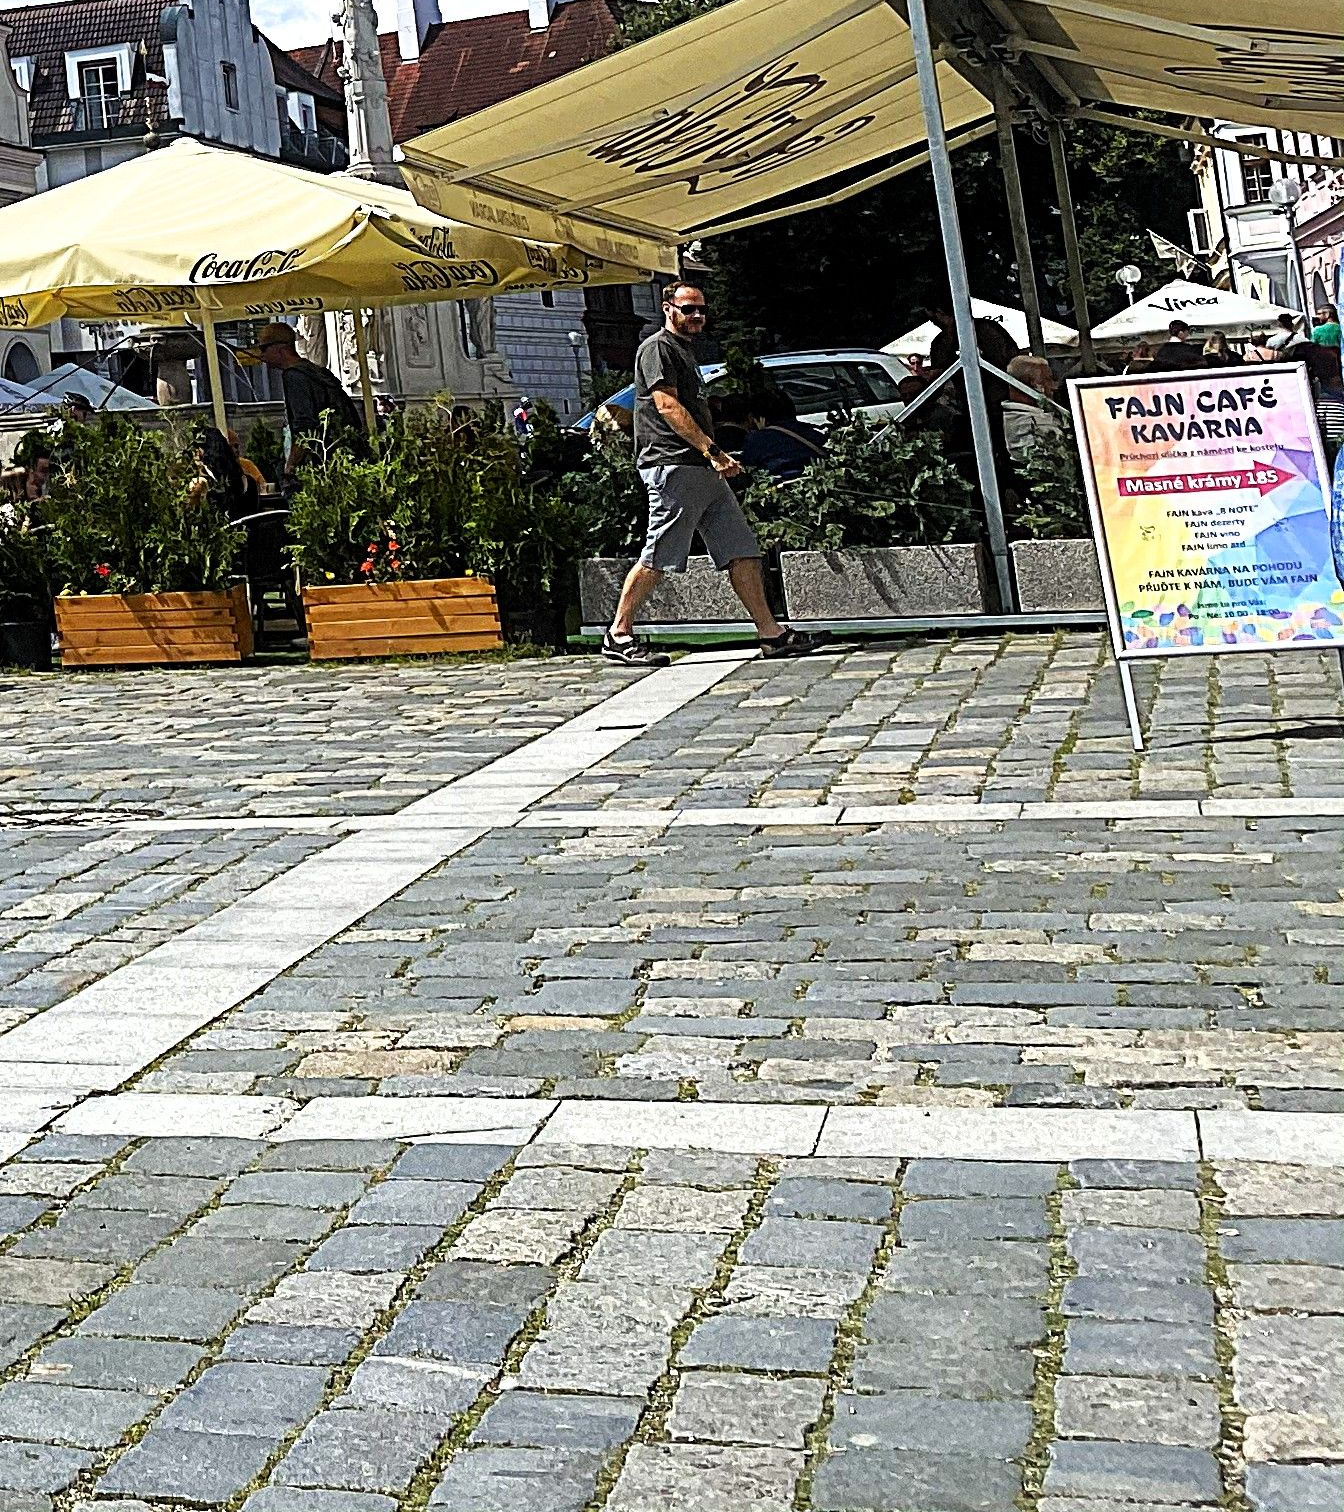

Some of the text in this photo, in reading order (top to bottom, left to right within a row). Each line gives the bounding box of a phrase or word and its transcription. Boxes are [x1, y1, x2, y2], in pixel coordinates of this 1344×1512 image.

[1147, 295, 1220, 314] Vinea
[1105, 378, 1278, 420] FAJN CAFÉ
[1131, 414, 1263, 445] KAVÁRNA
[1125, 469, 1279, 493] Masné krámy 185
[1148, 561, 1303, 579] FAJN KAVÁRNA NA POHODU
[1184, 580, 1192, 591] K
[1194, 577, 1226, 590] NÁM,
[1228, 576, 1259, 588] BUDE
[1260, 573, 1289, 586] VÁM
[1290, 573, 1318, 584] FAJN
